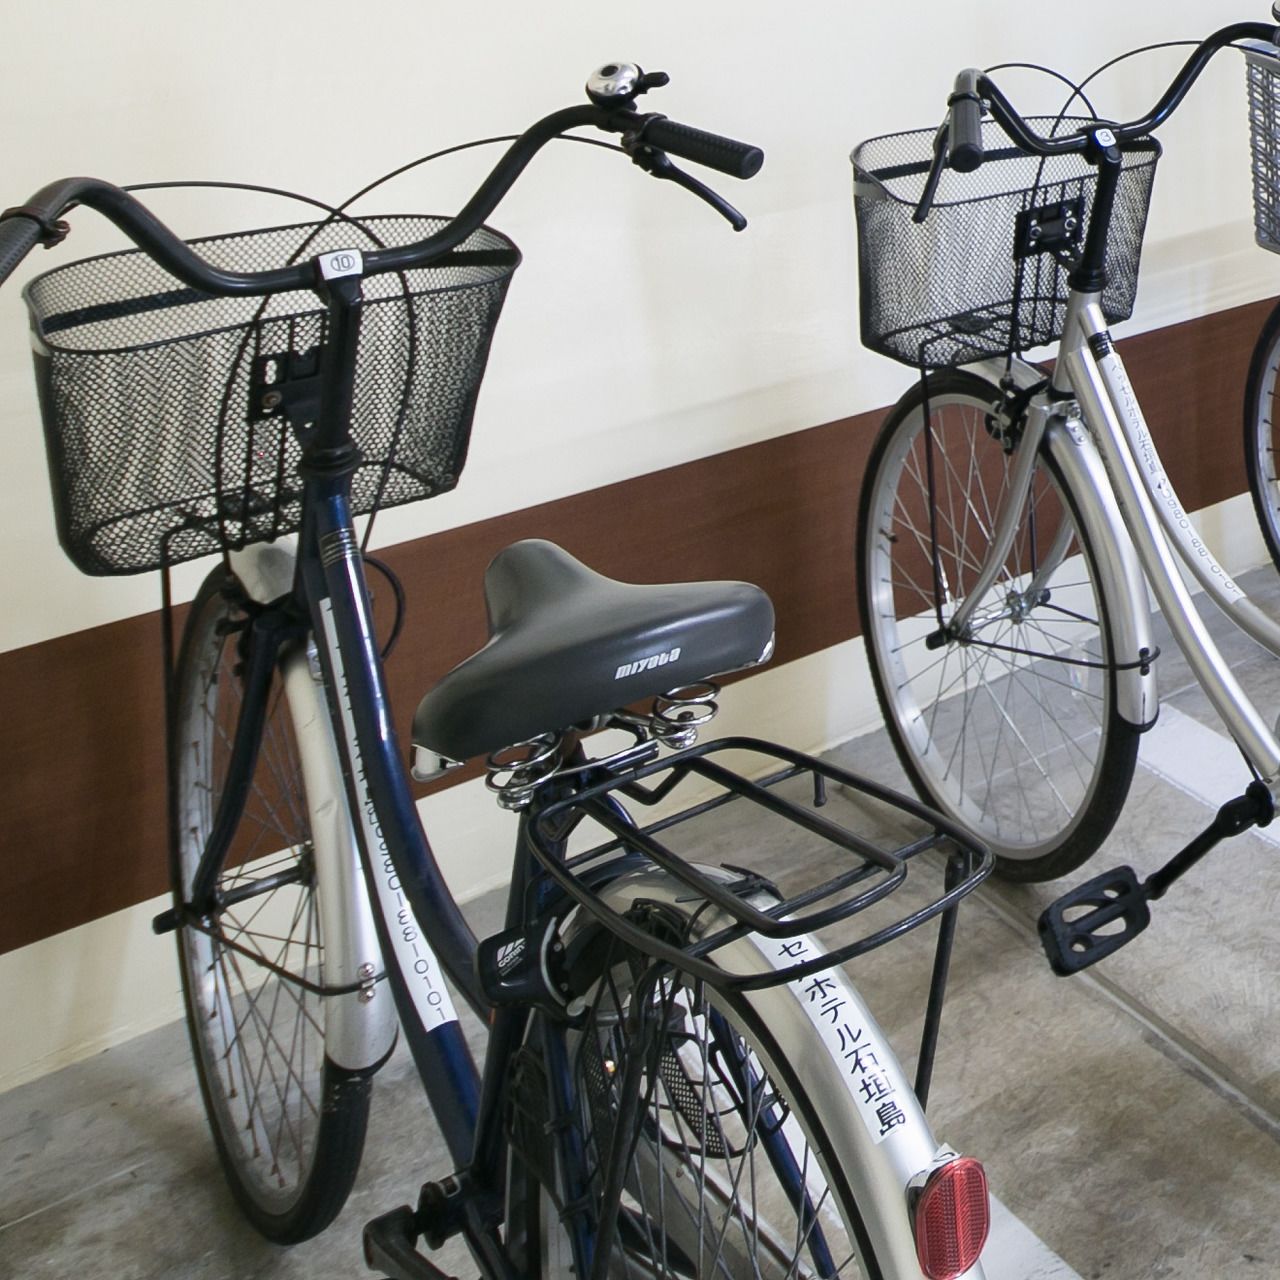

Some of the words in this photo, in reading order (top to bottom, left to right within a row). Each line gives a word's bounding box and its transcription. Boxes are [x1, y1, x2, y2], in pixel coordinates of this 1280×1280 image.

[614, 647, 681, 680] miyata
[777, 940, 907, 1137] セホテル石垣島
